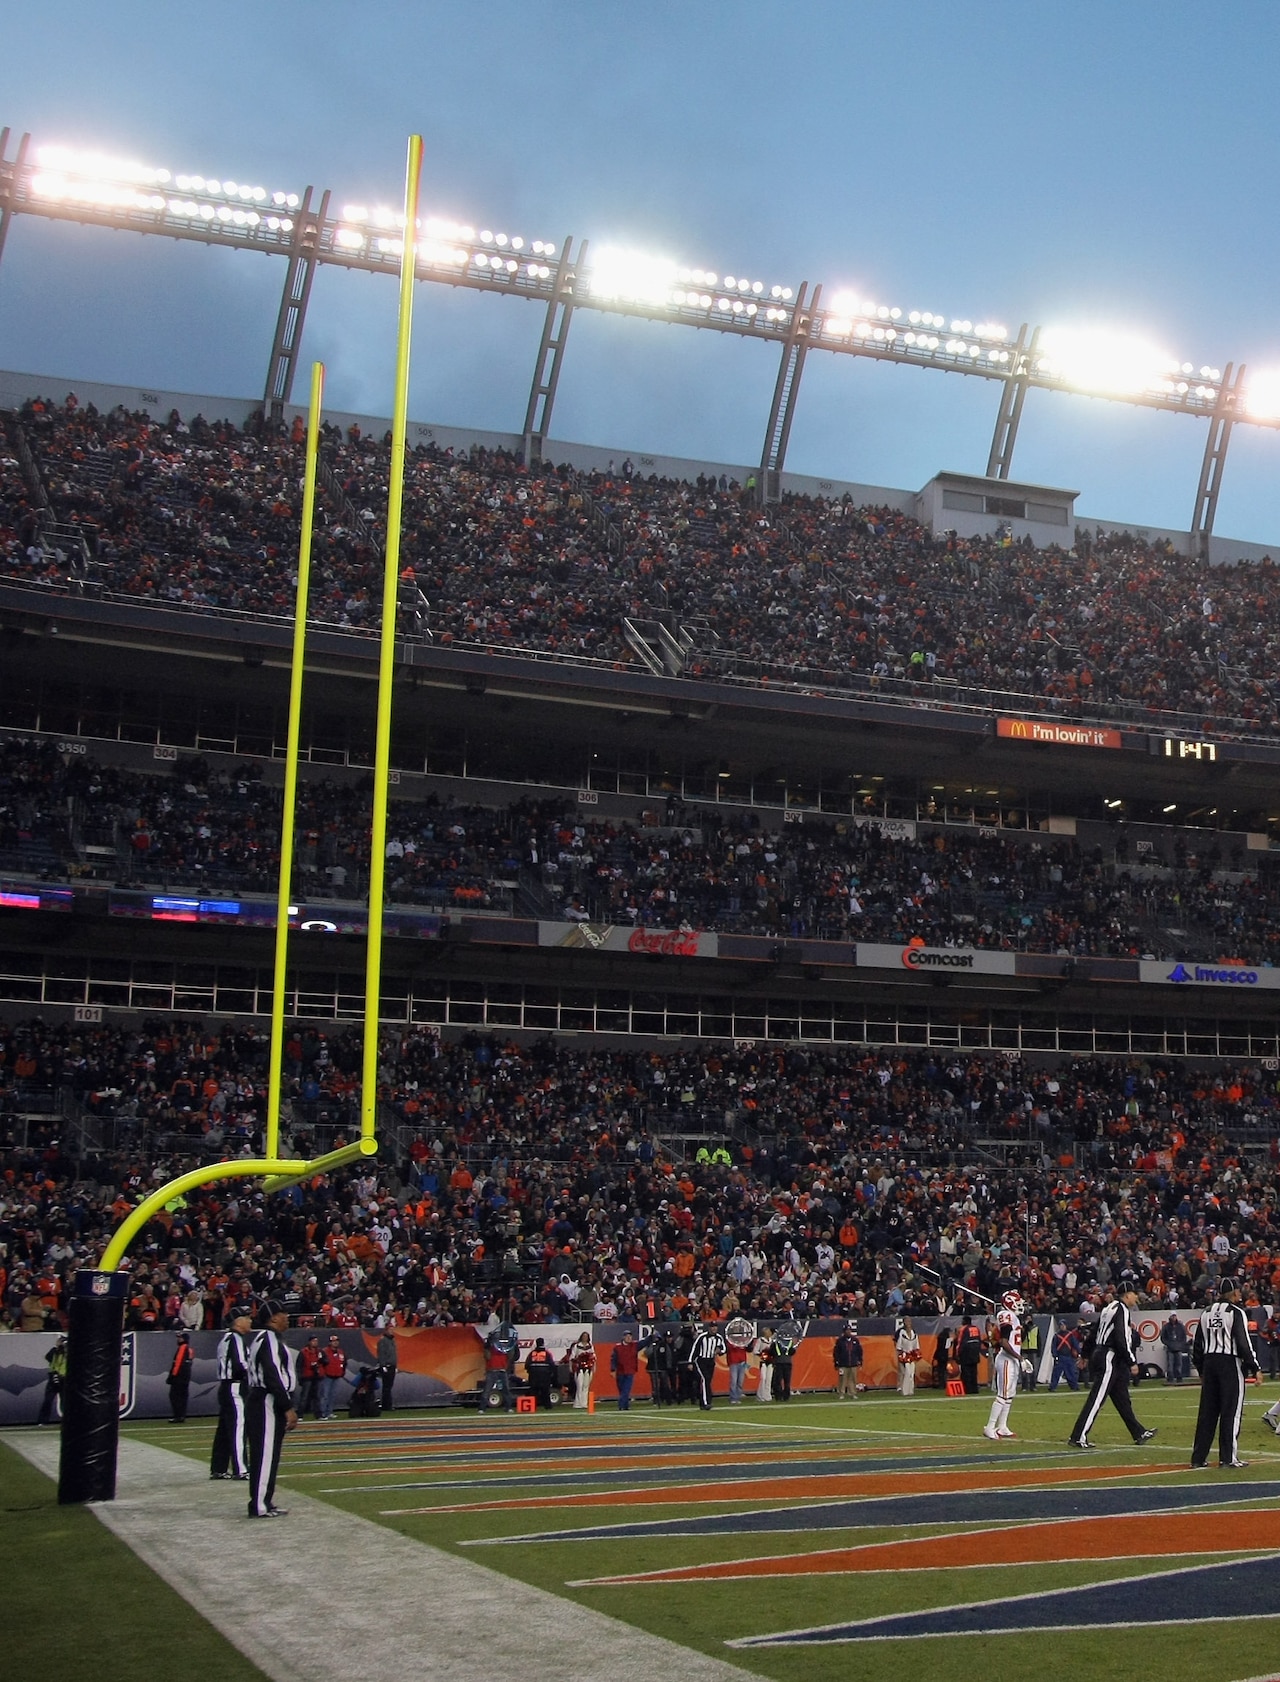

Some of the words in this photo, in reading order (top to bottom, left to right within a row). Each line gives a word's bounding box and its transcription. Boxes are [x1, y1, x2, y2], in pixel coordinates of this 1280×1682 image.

[1033, 725, 1055, 740] i'm
[1055, 727, 1092, 744] lovin'
[155, 748, 175, 759] 304
[1165, 739, 1216, 761] 11:47
[580, 792, 597, 801] 306
[902, 946, 974, 970] Comcast
[77, 1008, 99, 1020] 101
[129, 1176, 141, 1186] 47
[377, 1231, 388, 1241] 20
[600, 1308, 612, 1318] 26
[998, 1314, 1012, 1323] 24
[1208, 1318, 1223, 1328] 125
[950, 1383, 961, 1395] 10
[521, 1399, 531, 1412] G
